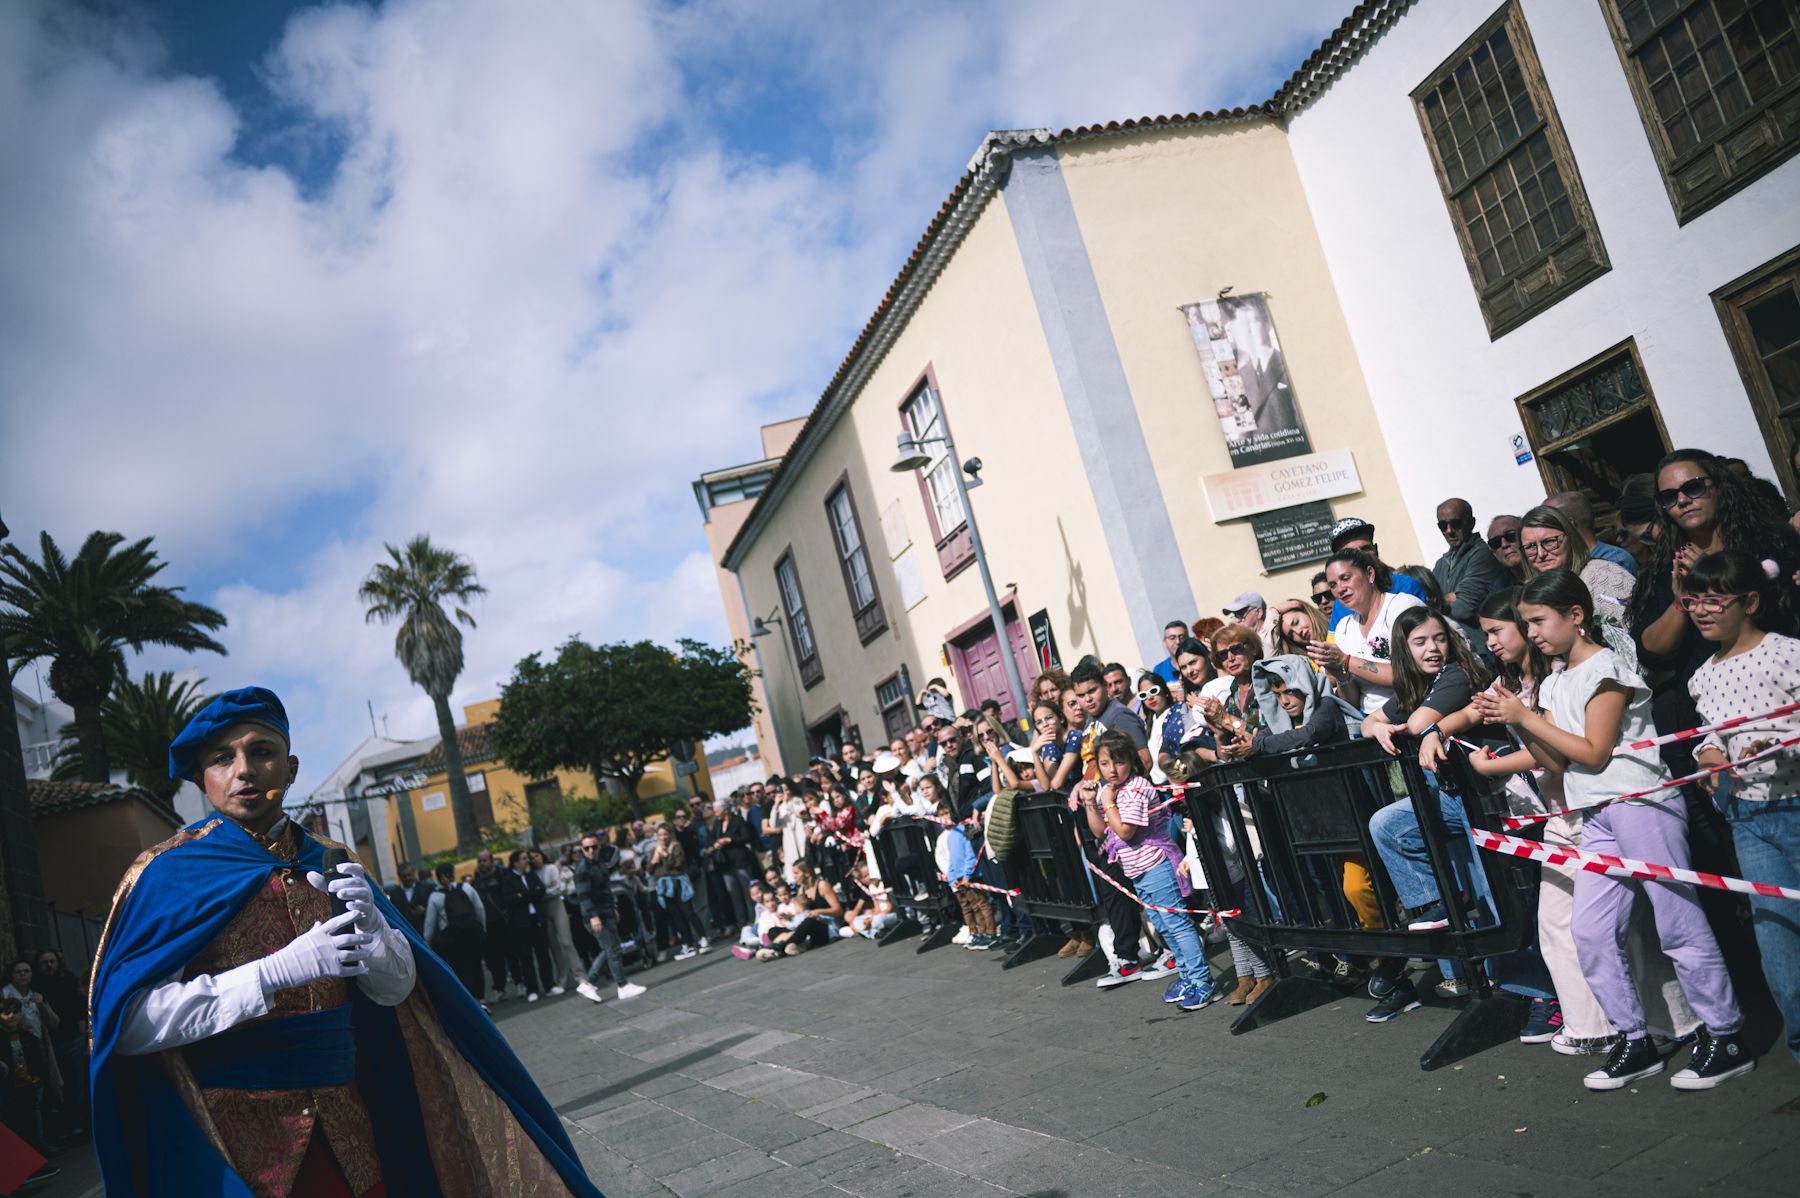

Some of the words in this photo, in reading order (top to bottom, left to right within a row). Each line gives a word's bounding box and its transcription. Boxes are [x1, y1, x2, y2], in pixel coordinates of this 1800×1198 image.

[1228, 438, 1246, 448] Arte
[1253, 433, 1269, 442] vida
[1229, 448, 1240, 456] en
[1239, 441, 1271, 453] Canarias
[1270, 461, 1328, 480] CAYETANO
[1315, 469, 1350, 485] FELIPE
[1332, 519, 1362, 535] adidas
